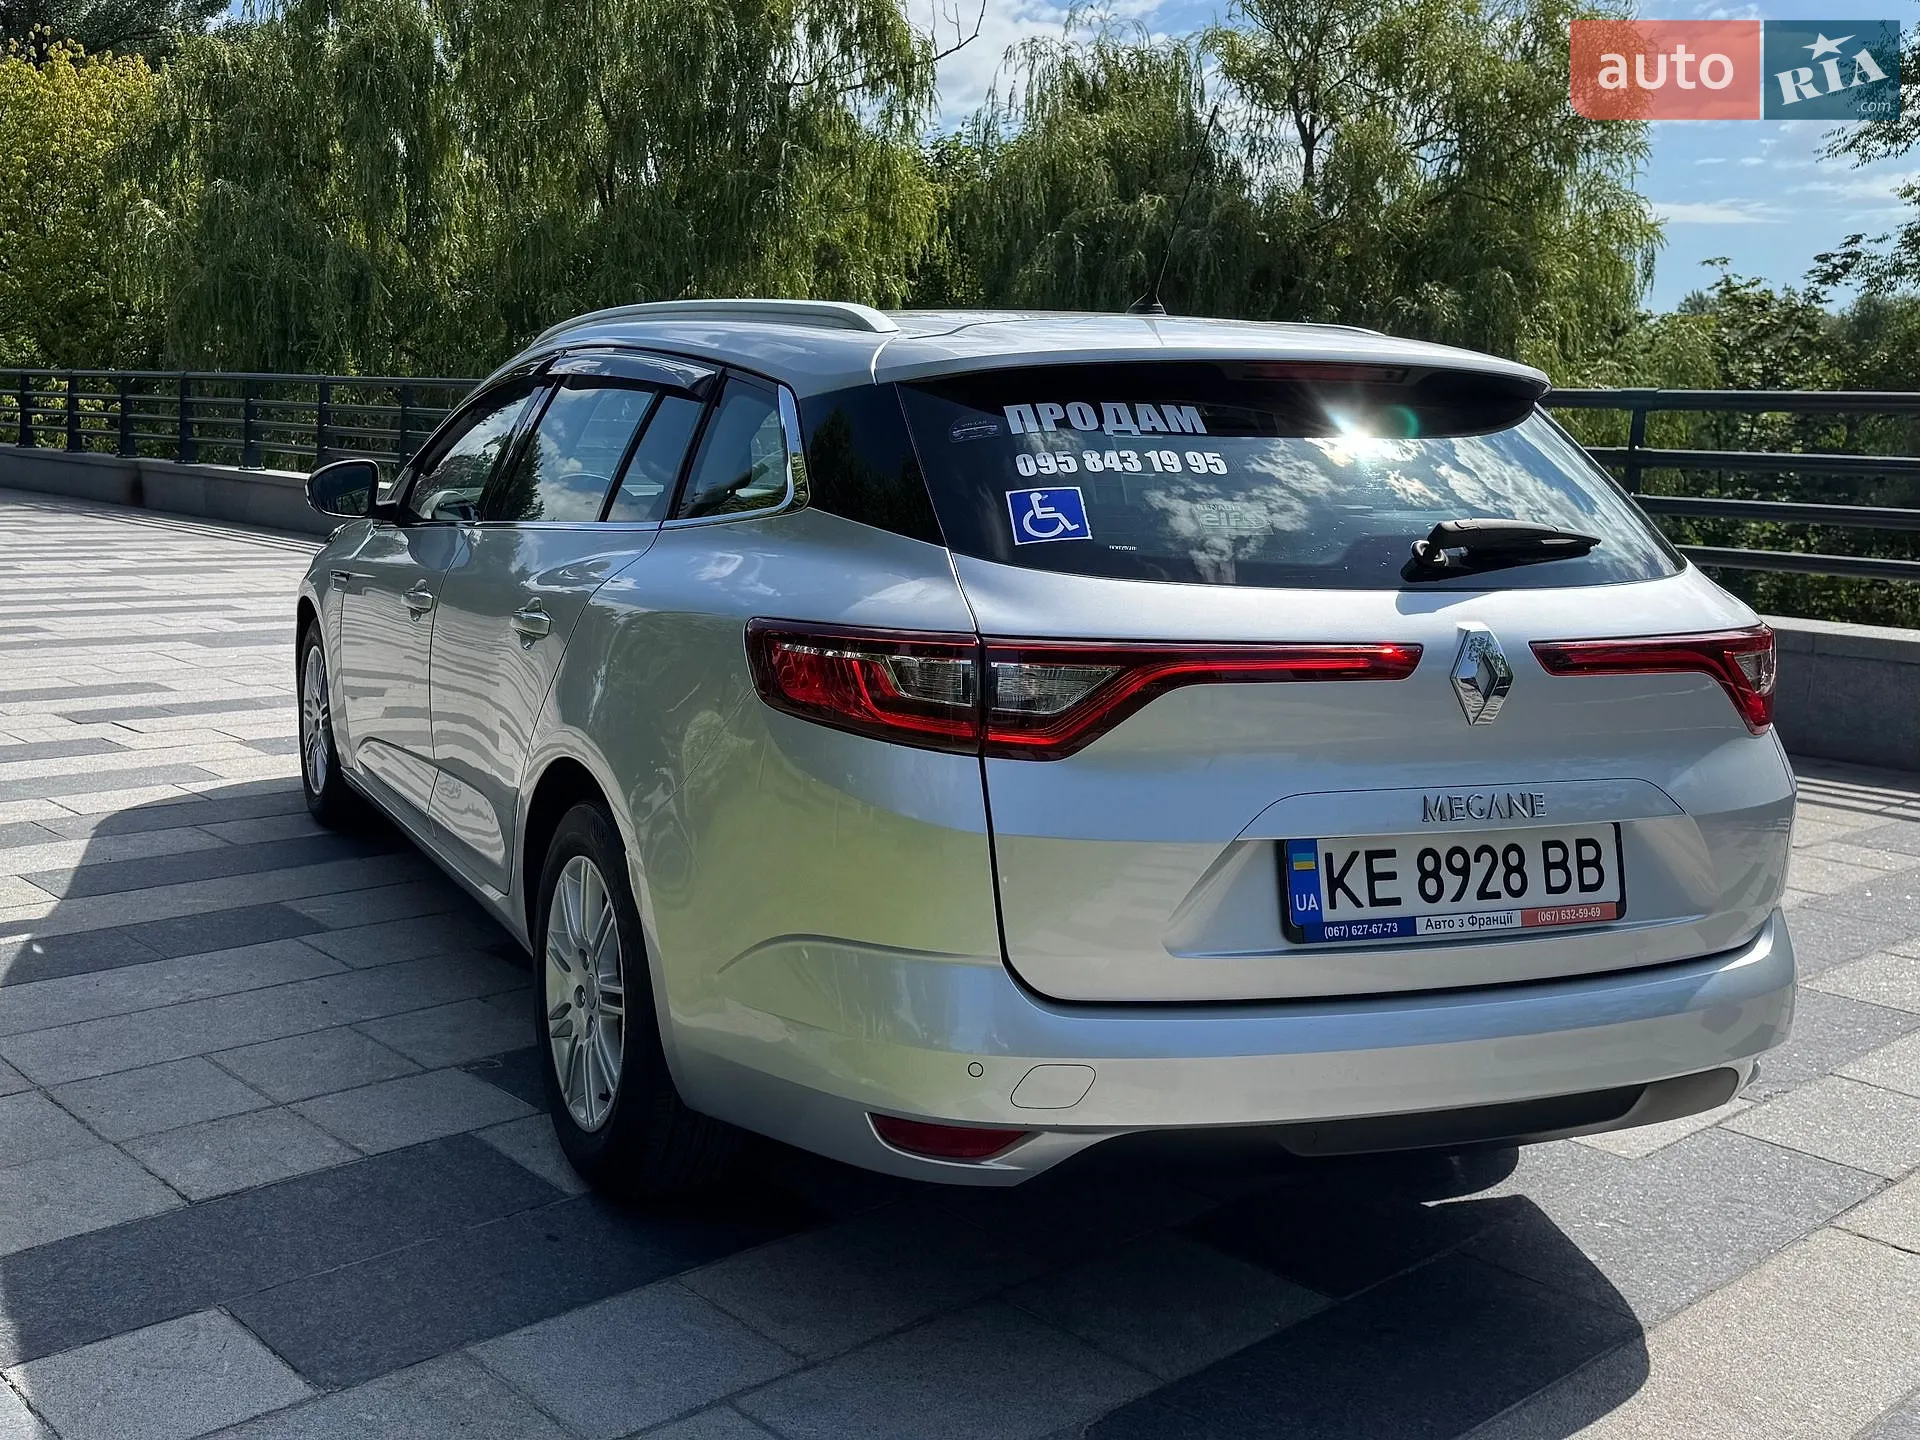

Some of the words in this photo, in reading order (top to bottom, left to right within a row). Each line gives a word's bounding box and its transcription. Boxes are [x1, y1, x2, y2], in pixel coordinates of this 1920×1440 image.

[1003, 402, 1207, 436] ПРОДАМ
[1015, 452, 1078, 477] 095
[1082, 450, 1142, 473] 843
[1144, 450, 1182, 473] 19
[1185, 451, 1228, 475] 95
[1421, 791, 1546, 823] MEGANE
[1324, 848, 1402, 910] KE
[1416, 843, 1528, 904] 8928
[1541, 837, 1605, 895] BB
[1295, 893, 1319, 912] UA
[1424, 916, 1454, 931] Авто
[1458, 917, 1465, 928] з
[1467, 911, 1514, 929] Франції
[1537, 911, 1559, 923] (067)
[1560, 907, 1601, 920] 632-59-69
[1324, 926, 1349, 939] (067)
[1351, 922, 1398, 937] 627-67-73
